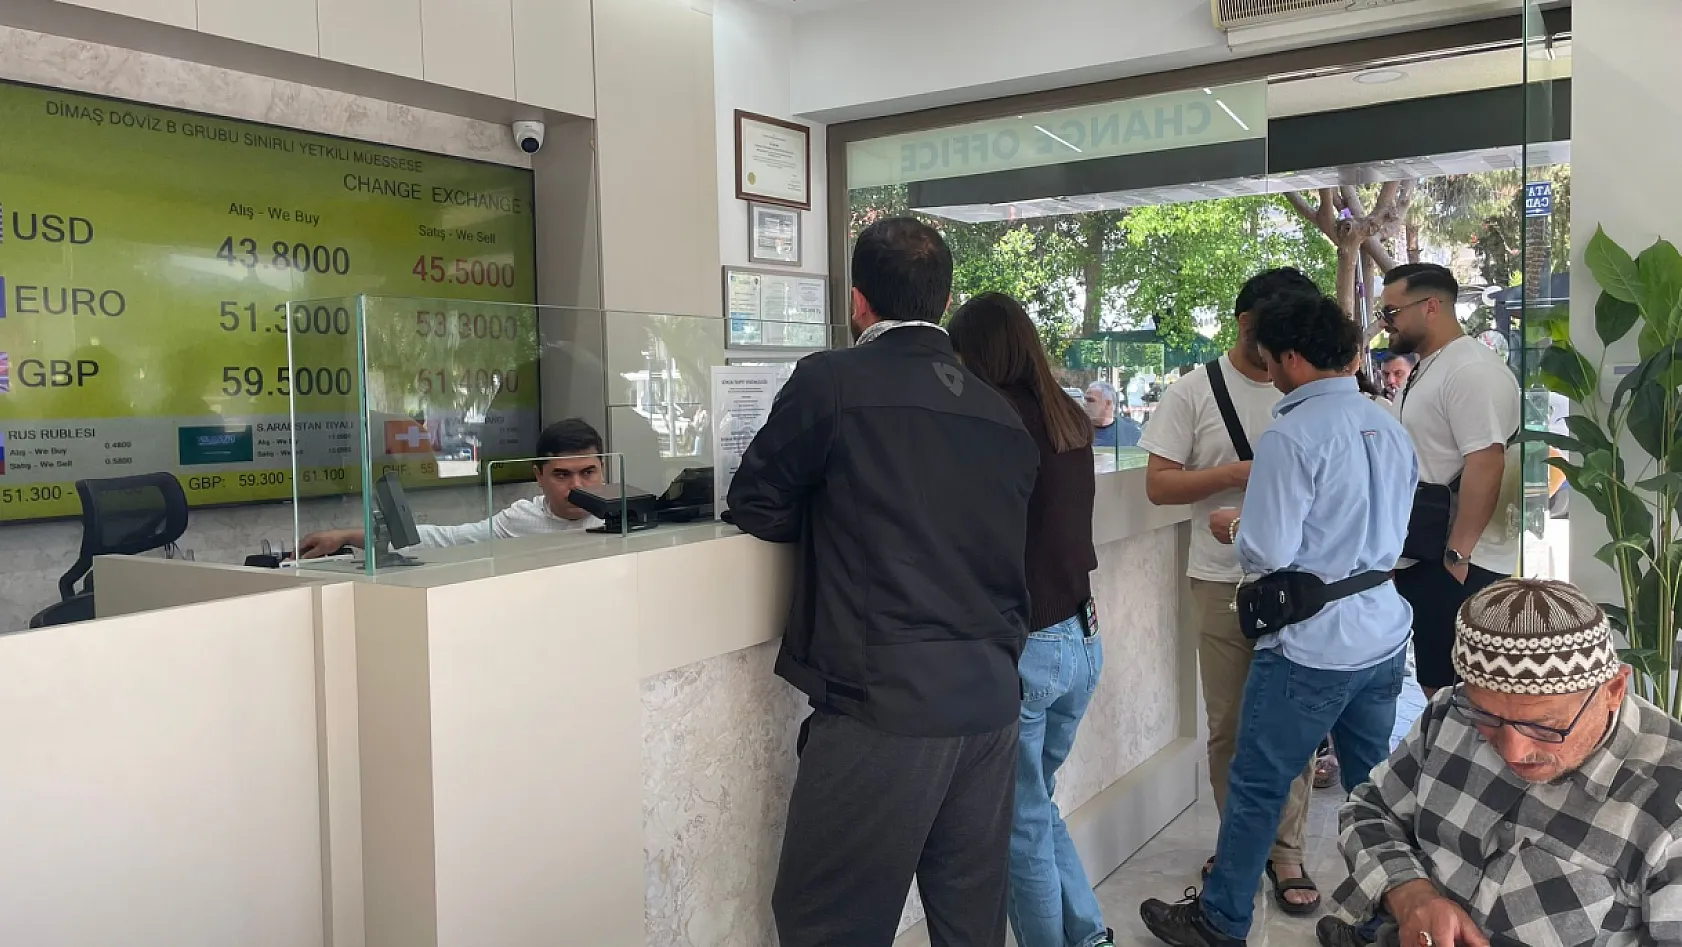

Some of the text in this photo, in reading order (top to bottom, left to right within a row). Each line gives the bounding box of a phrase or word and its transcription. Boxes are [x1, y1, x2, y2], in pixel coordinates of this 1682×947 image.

[46, 100, 104, 126] DİMAŞ
[166, 119, 177, 134] B
[182, 122, 239, 143] GRUBU
[243, 132, 295, 153] SINIRLI
[343, 173, 522, 215] CHANGE EXCHANGE
[12, 210, 94, 245] USD
[228, 202, 254, 221] Alış
[267, 206, 291, 222] We
[295, 209, 320, 227] Buy
[418, 224, 446, 242] Satış
[455, 228, 474, 242] We
[476, 230, 496, 244] Sell
[216, 235, 350, 276] 43.8000
[412, 254, 515, 289] 45.5000
[14, 285, 127, 318] EURO
[219, 300, 350, 334] 51.3000
[17, 358, 99, 388] GBP
[221, 365, 351, 397] 59.5000
[8, 429, 37, 441] RUS
[1, 485, 62, 504] 51.300
[188, 475, 226, 491] GBP:
[238, 471, 285, 487] 59.300
[302, 467, 345, 483] 61.100
